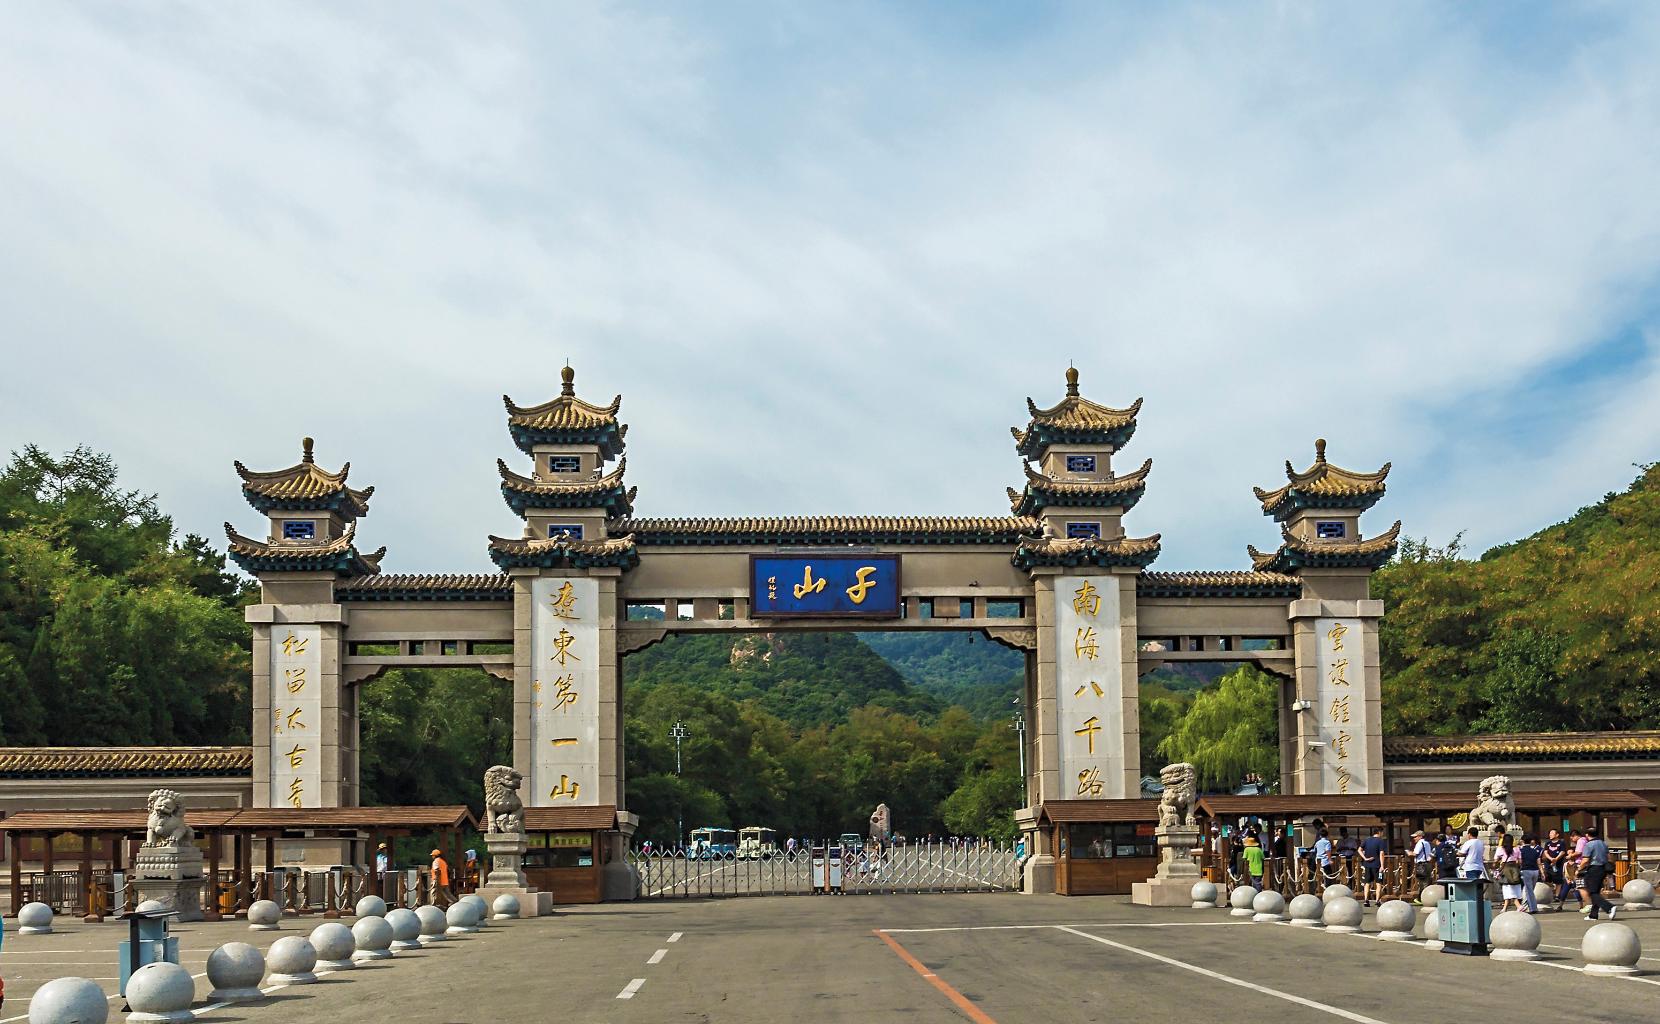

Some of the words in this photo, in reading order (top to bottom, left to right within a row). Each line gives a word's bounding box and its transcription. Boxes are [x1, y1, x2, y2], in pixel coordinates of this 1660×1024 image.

[1073, 580, 1106, 797] 南海八千路
